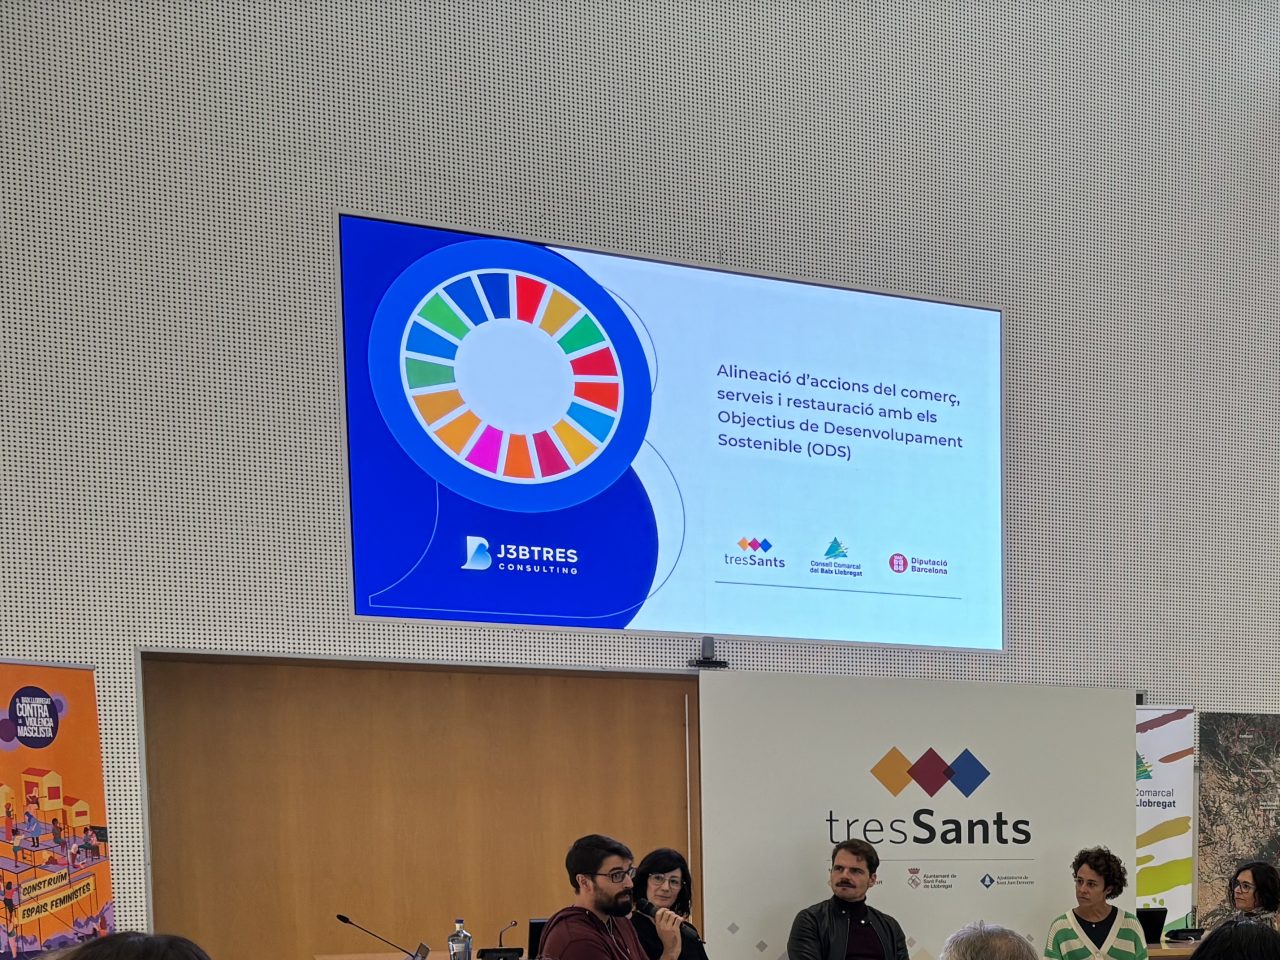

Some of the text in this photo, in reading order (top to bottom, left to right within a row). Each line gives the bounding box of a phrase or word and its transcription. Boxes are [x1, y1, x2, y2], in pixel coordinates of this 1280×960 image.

[716, 363, 792, 385] Alineació
[873, 382, 896, 397] del
[900, 387, 961, 407] comerç,
[717, 389, 938, 423] serveis i restauració amb els
[717, 410, 963, 448] Objectius de Desenvolupament
[717, 433, 852, 462] Sostenible (ODS)
[496, 544, 578, 563] J3BTRES
[724, 553, 786, 569] tresSants
[911, 557, 948, 567] Diputació
[498, 562, 578, 575] CONSULTING
[810, 560, 862, 570] Consell Comarcal
[834, 568, 863, 578] Llobregat
[911, 565, 948, 575] Barcelona
[16, 703, 50, 718] CONTRA
[17, 725, 53, 738] MASCLISTA
[825, 808, 1032, 845] tresSants
[22, 871, 68, 896] CONSTRUÏM
[22, 882, 91, 919] ESPAIS FEMINISTES
